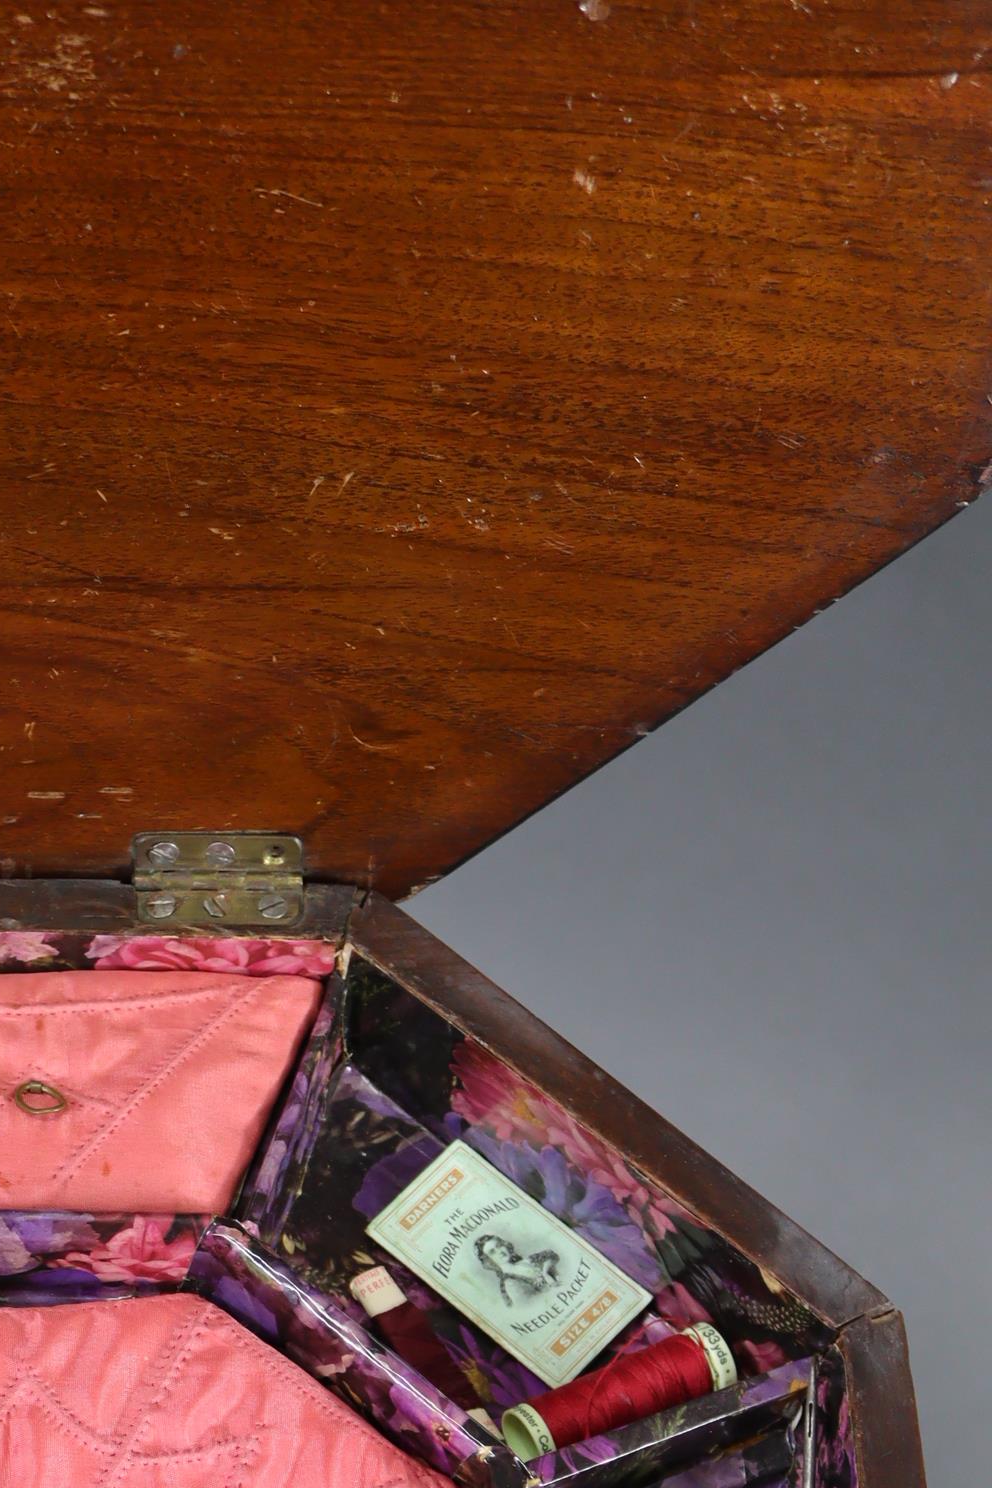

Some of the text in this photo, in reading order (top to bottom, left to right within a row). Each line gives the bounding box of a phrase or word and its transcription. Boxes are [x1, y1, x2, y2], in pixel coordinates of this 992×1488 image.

[406, 1173, 458, 1225] DARNERS
[445, 1208, 465, 1226] THE
[432, 1243, 457, 1279] FLORA
[453, 1197, 519, 1244] MACDONALD
[511, 1304, 560, 1337] NEEDLE
[557, 1258, 594, 1308] PACKET
[558, 1317, 590, 1350] SIZE
[591, 1295, 614, 1322] 4/8
